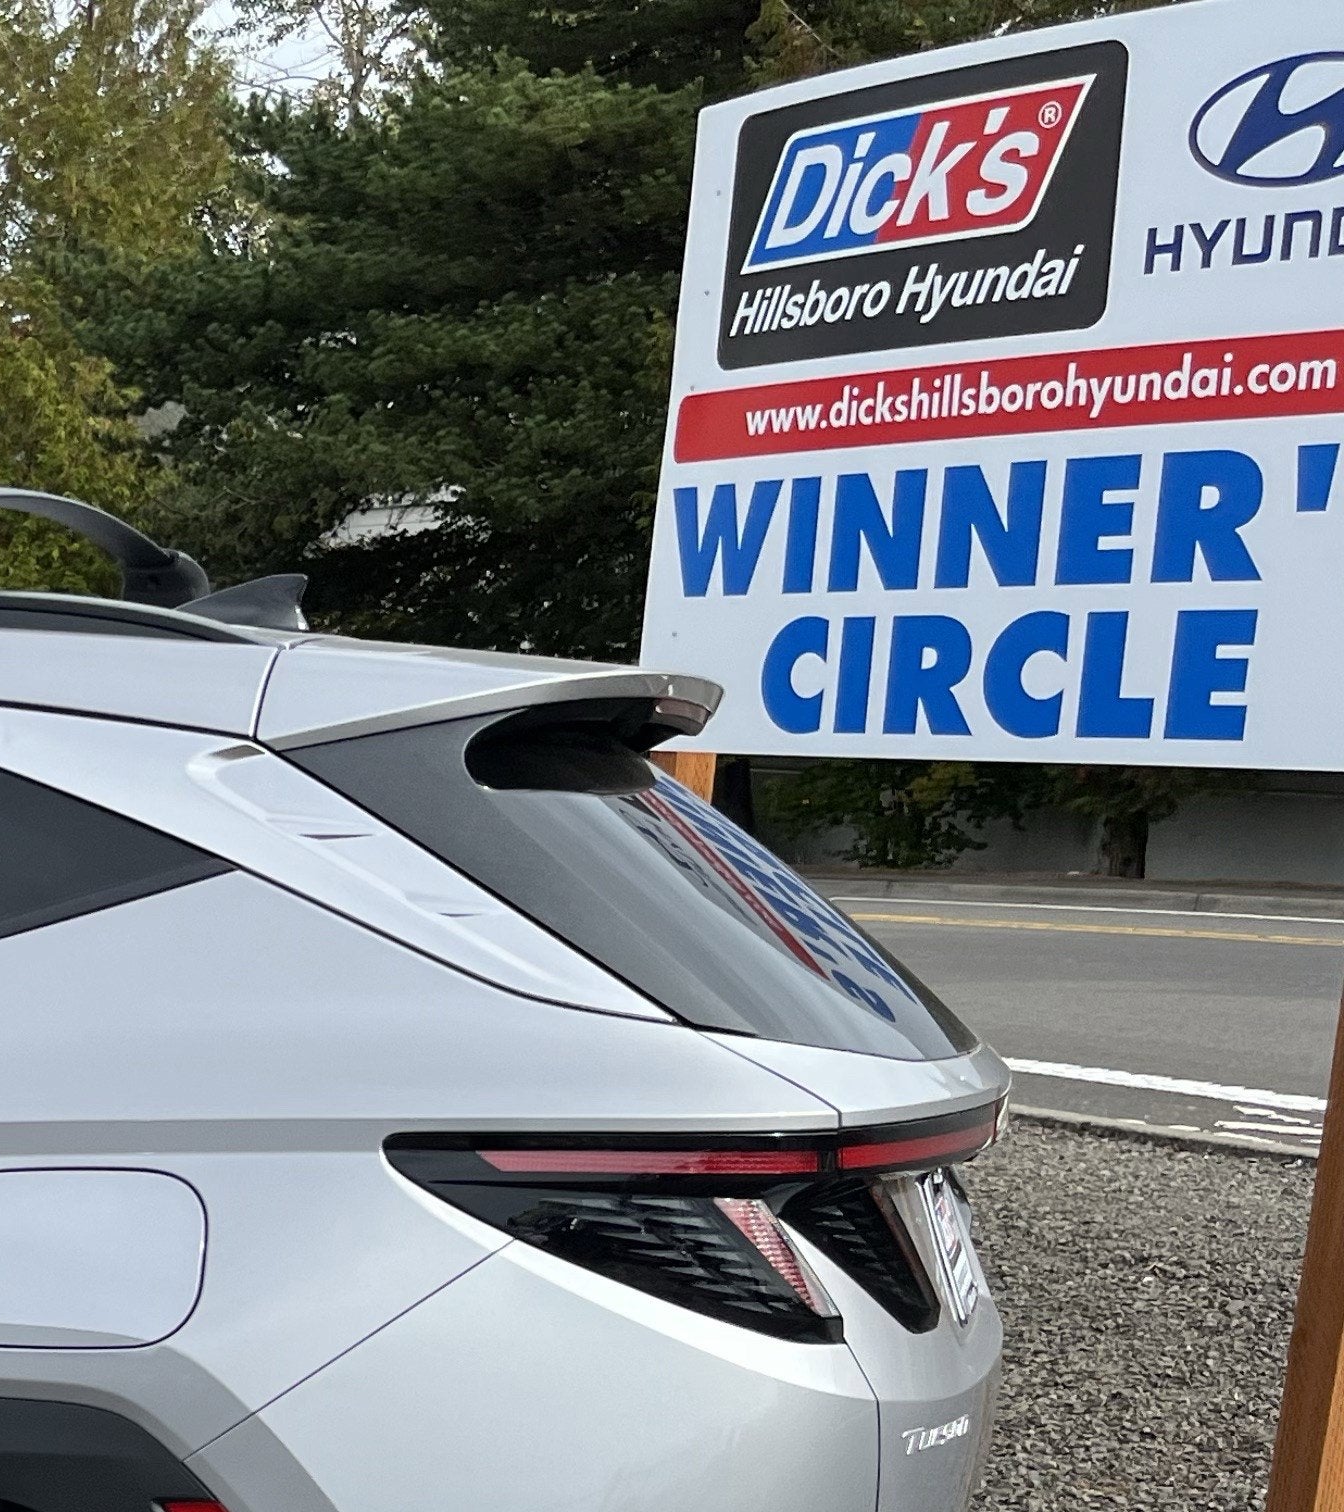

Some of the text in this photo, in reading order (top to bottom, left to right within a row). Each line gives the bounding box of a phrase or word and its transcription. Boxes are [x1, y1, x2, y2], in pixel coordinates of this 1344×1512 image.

[728, 243, 1087, 338] Hillsboro Hyundai
[745, 352, 1338, 437] www.dickshillsborohyundai.com
[760, 608, 1260, 742] CIRCLE
